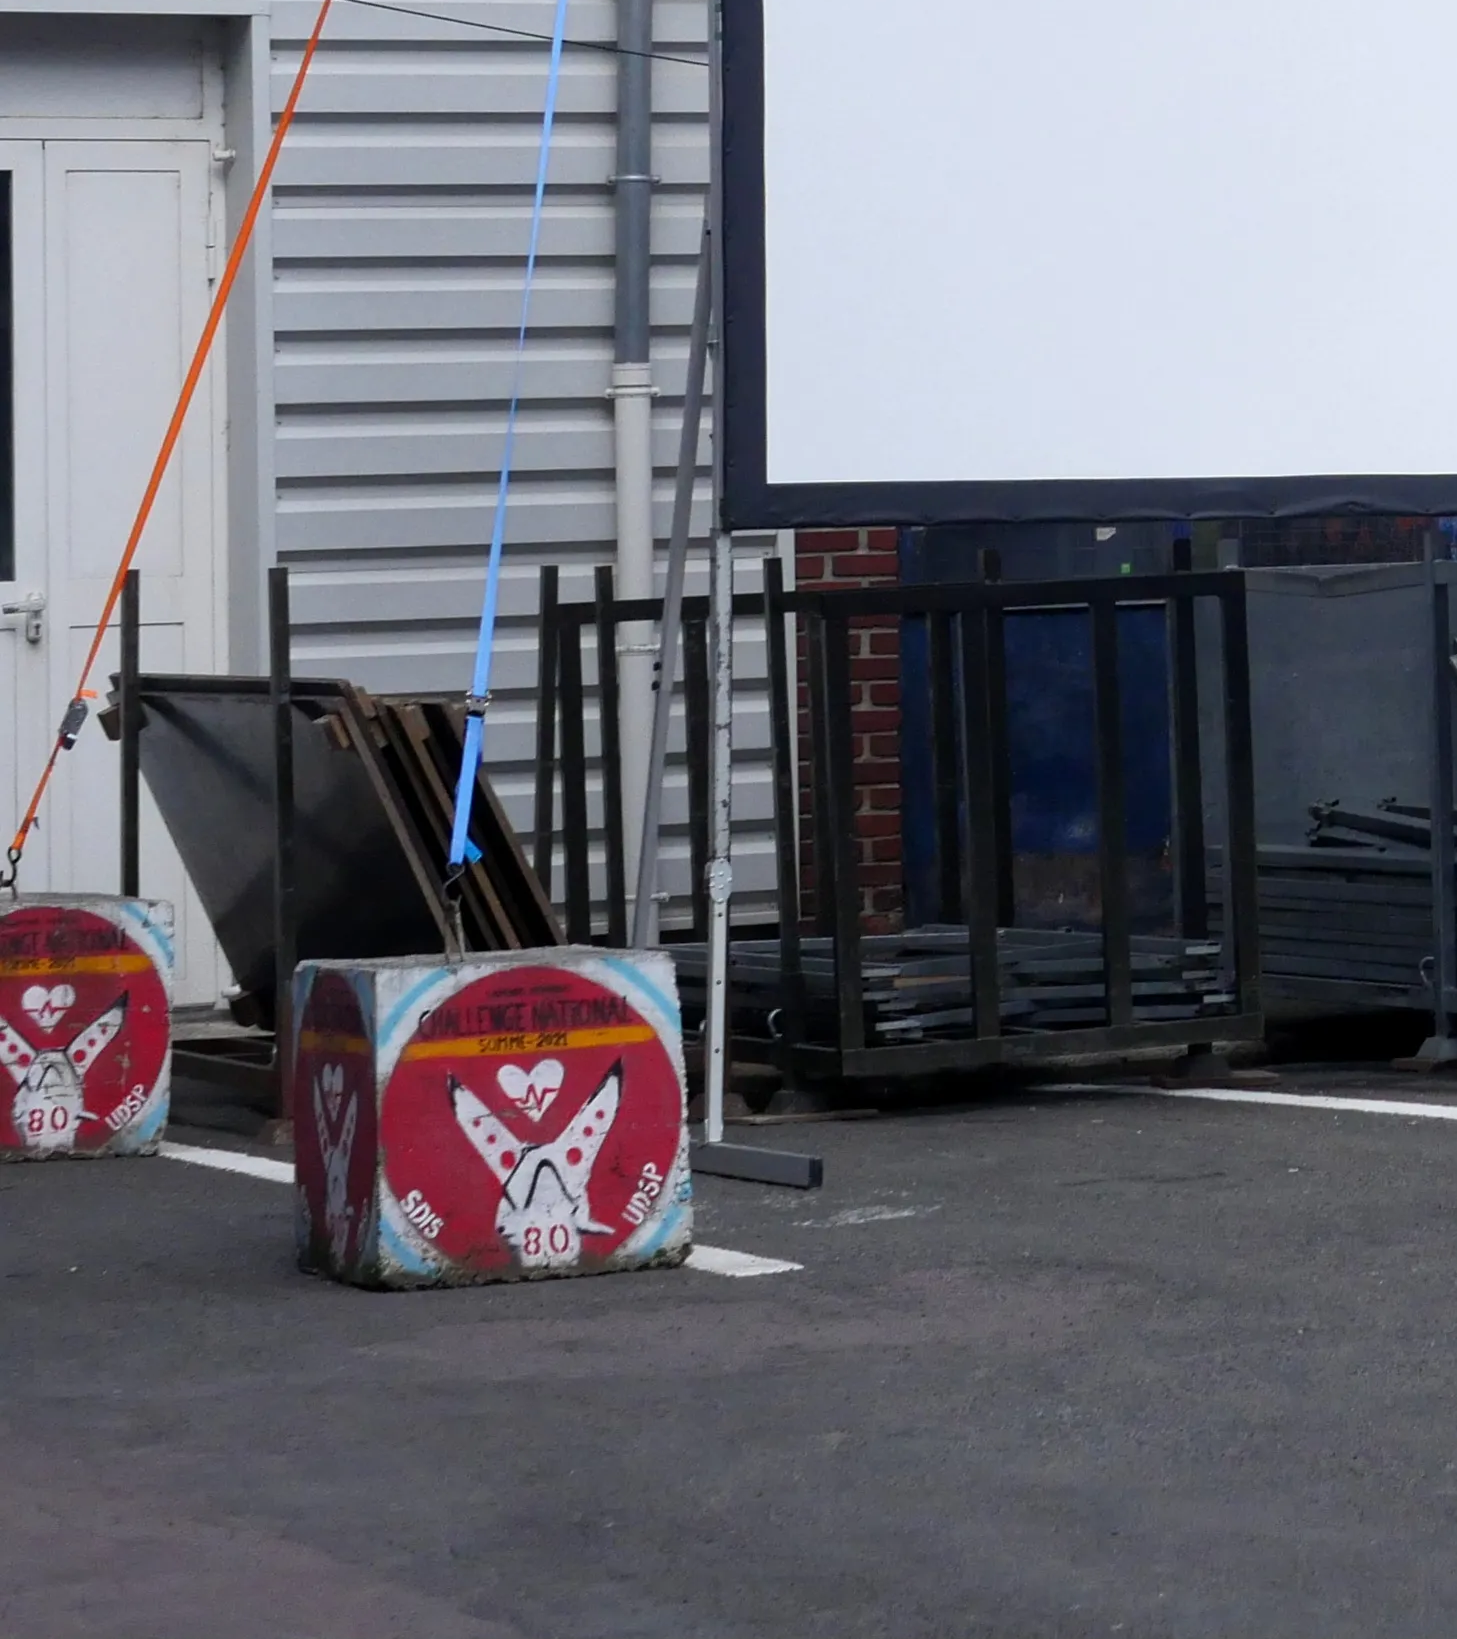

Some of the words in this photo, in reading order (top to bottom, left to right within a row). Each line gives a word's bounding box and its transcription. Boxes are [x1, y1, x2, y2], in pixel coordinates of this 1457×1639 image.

[27, 1106, 69, 1134] 80
[104, 1082, 149, 1132] UDSP
[401, 1189, 444, 1239] SDIS
[621, 1162, 664, 1226] UDSP
[523, 1223, 570, 1255] 80
